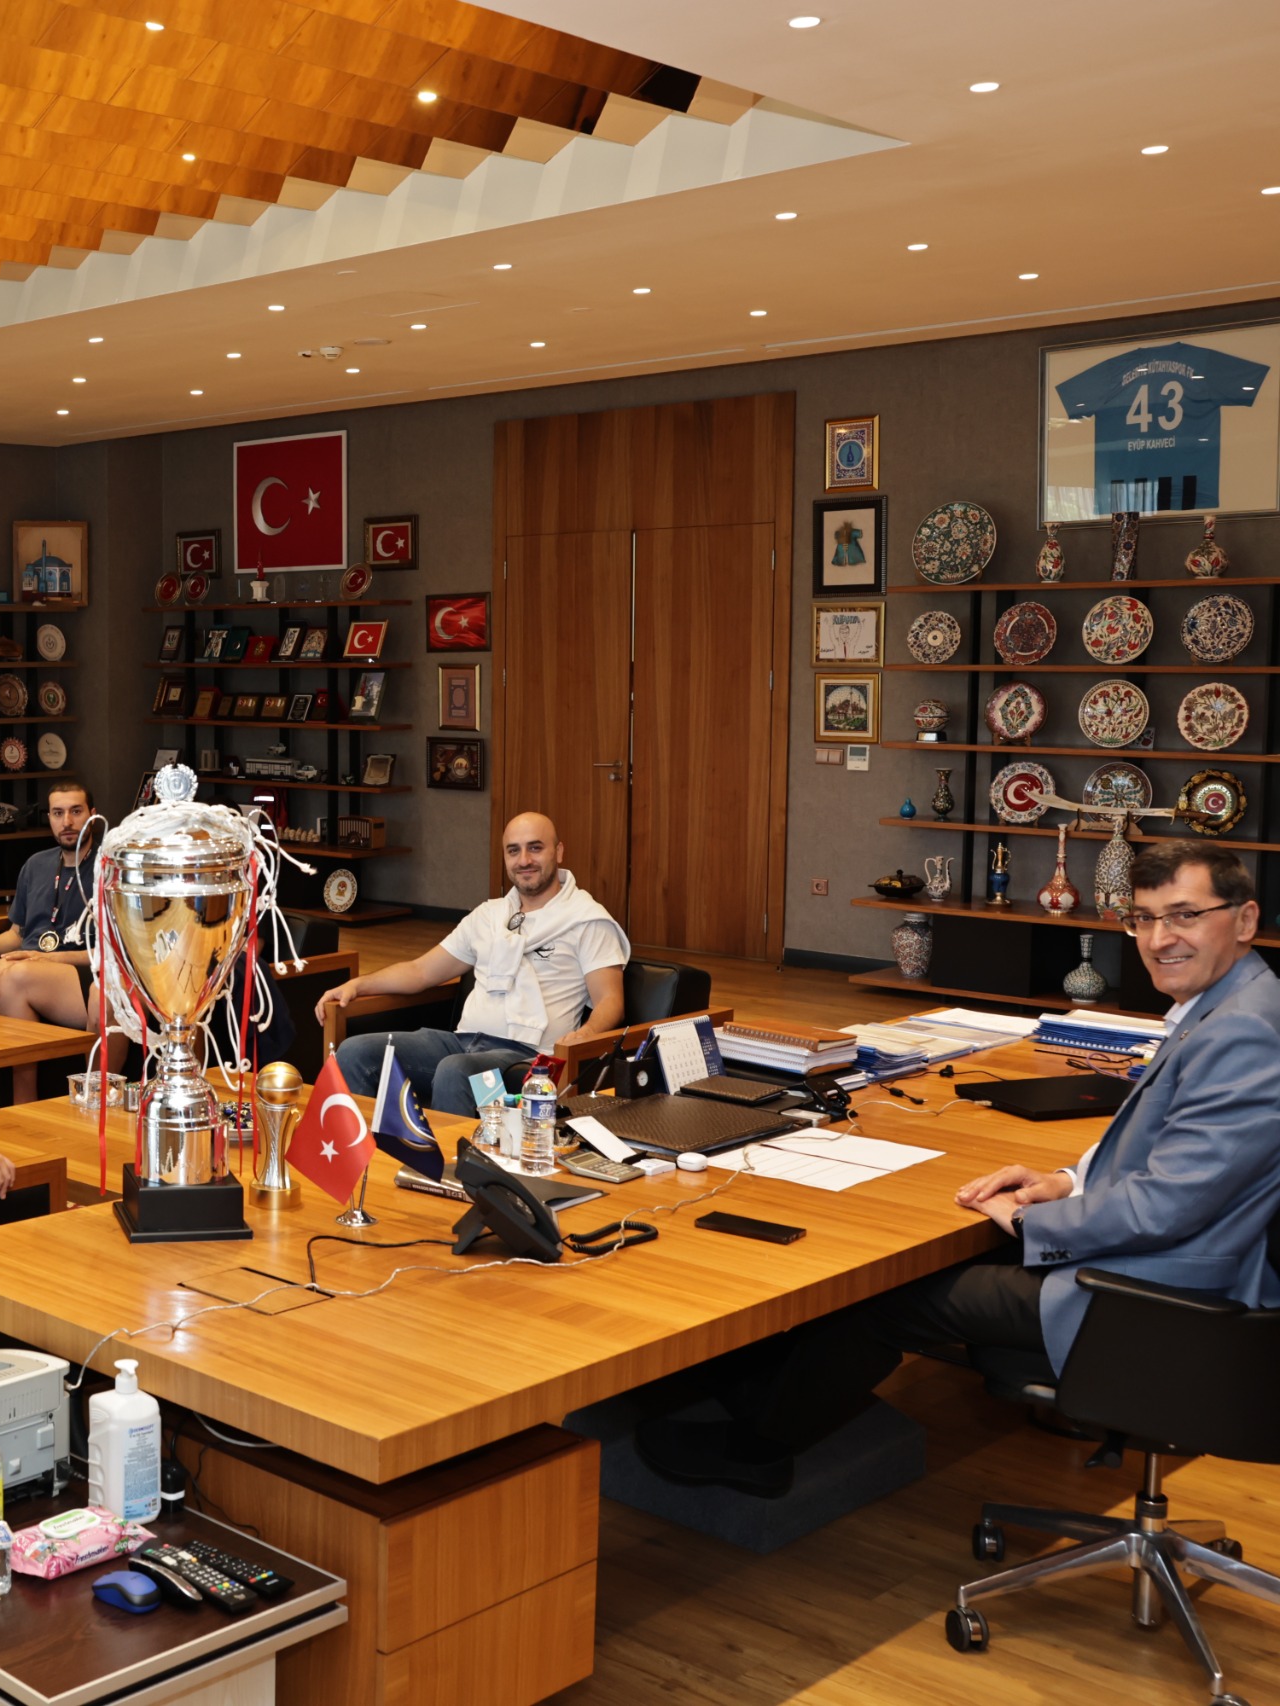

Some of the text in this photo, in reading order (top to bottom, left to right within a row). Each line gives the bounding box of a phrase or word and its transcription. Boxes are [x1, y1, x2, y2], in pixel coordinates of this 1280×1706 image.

[1126, 381, 1184, 433] 43
[1128, 435, 1176, 452] EYÜP KAHVECİ
